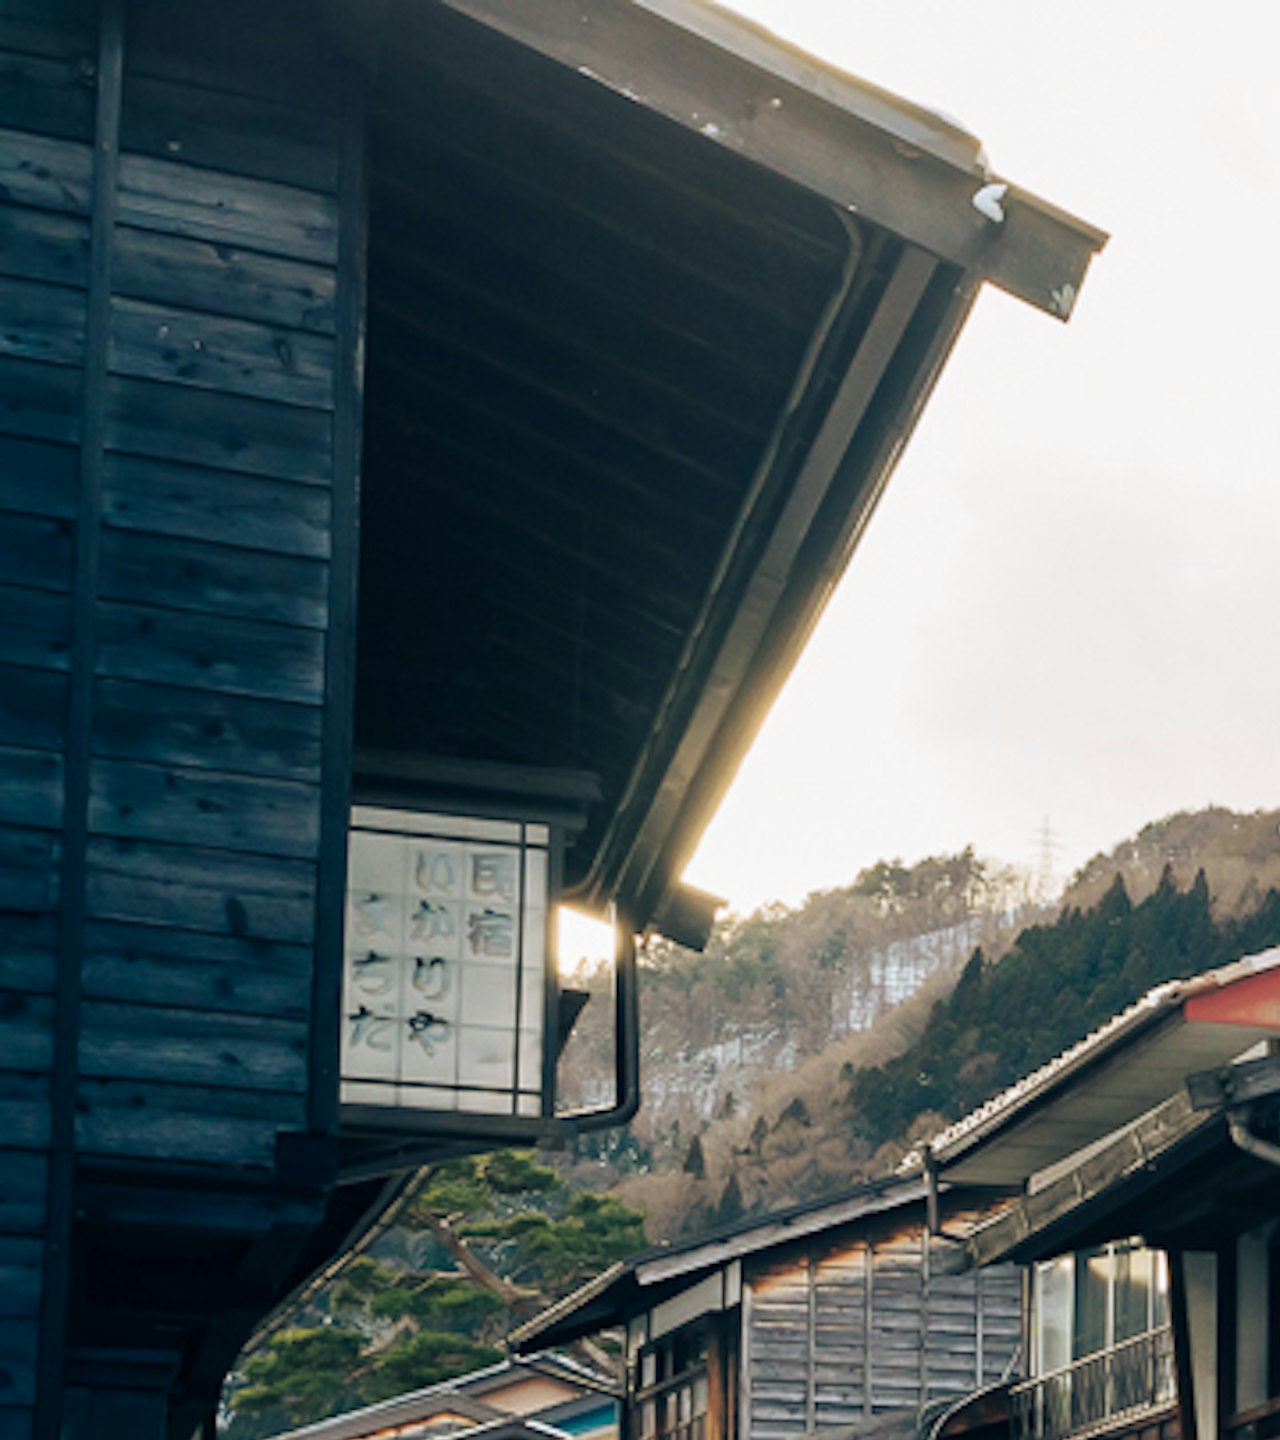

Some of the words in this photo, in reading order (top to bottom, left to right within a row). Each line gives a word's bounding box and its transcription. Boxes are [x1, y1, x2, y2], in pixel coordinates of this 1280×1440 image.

[348, 891, 396, 1053] まちだ
[466, 852, 515, 959] 民宿
